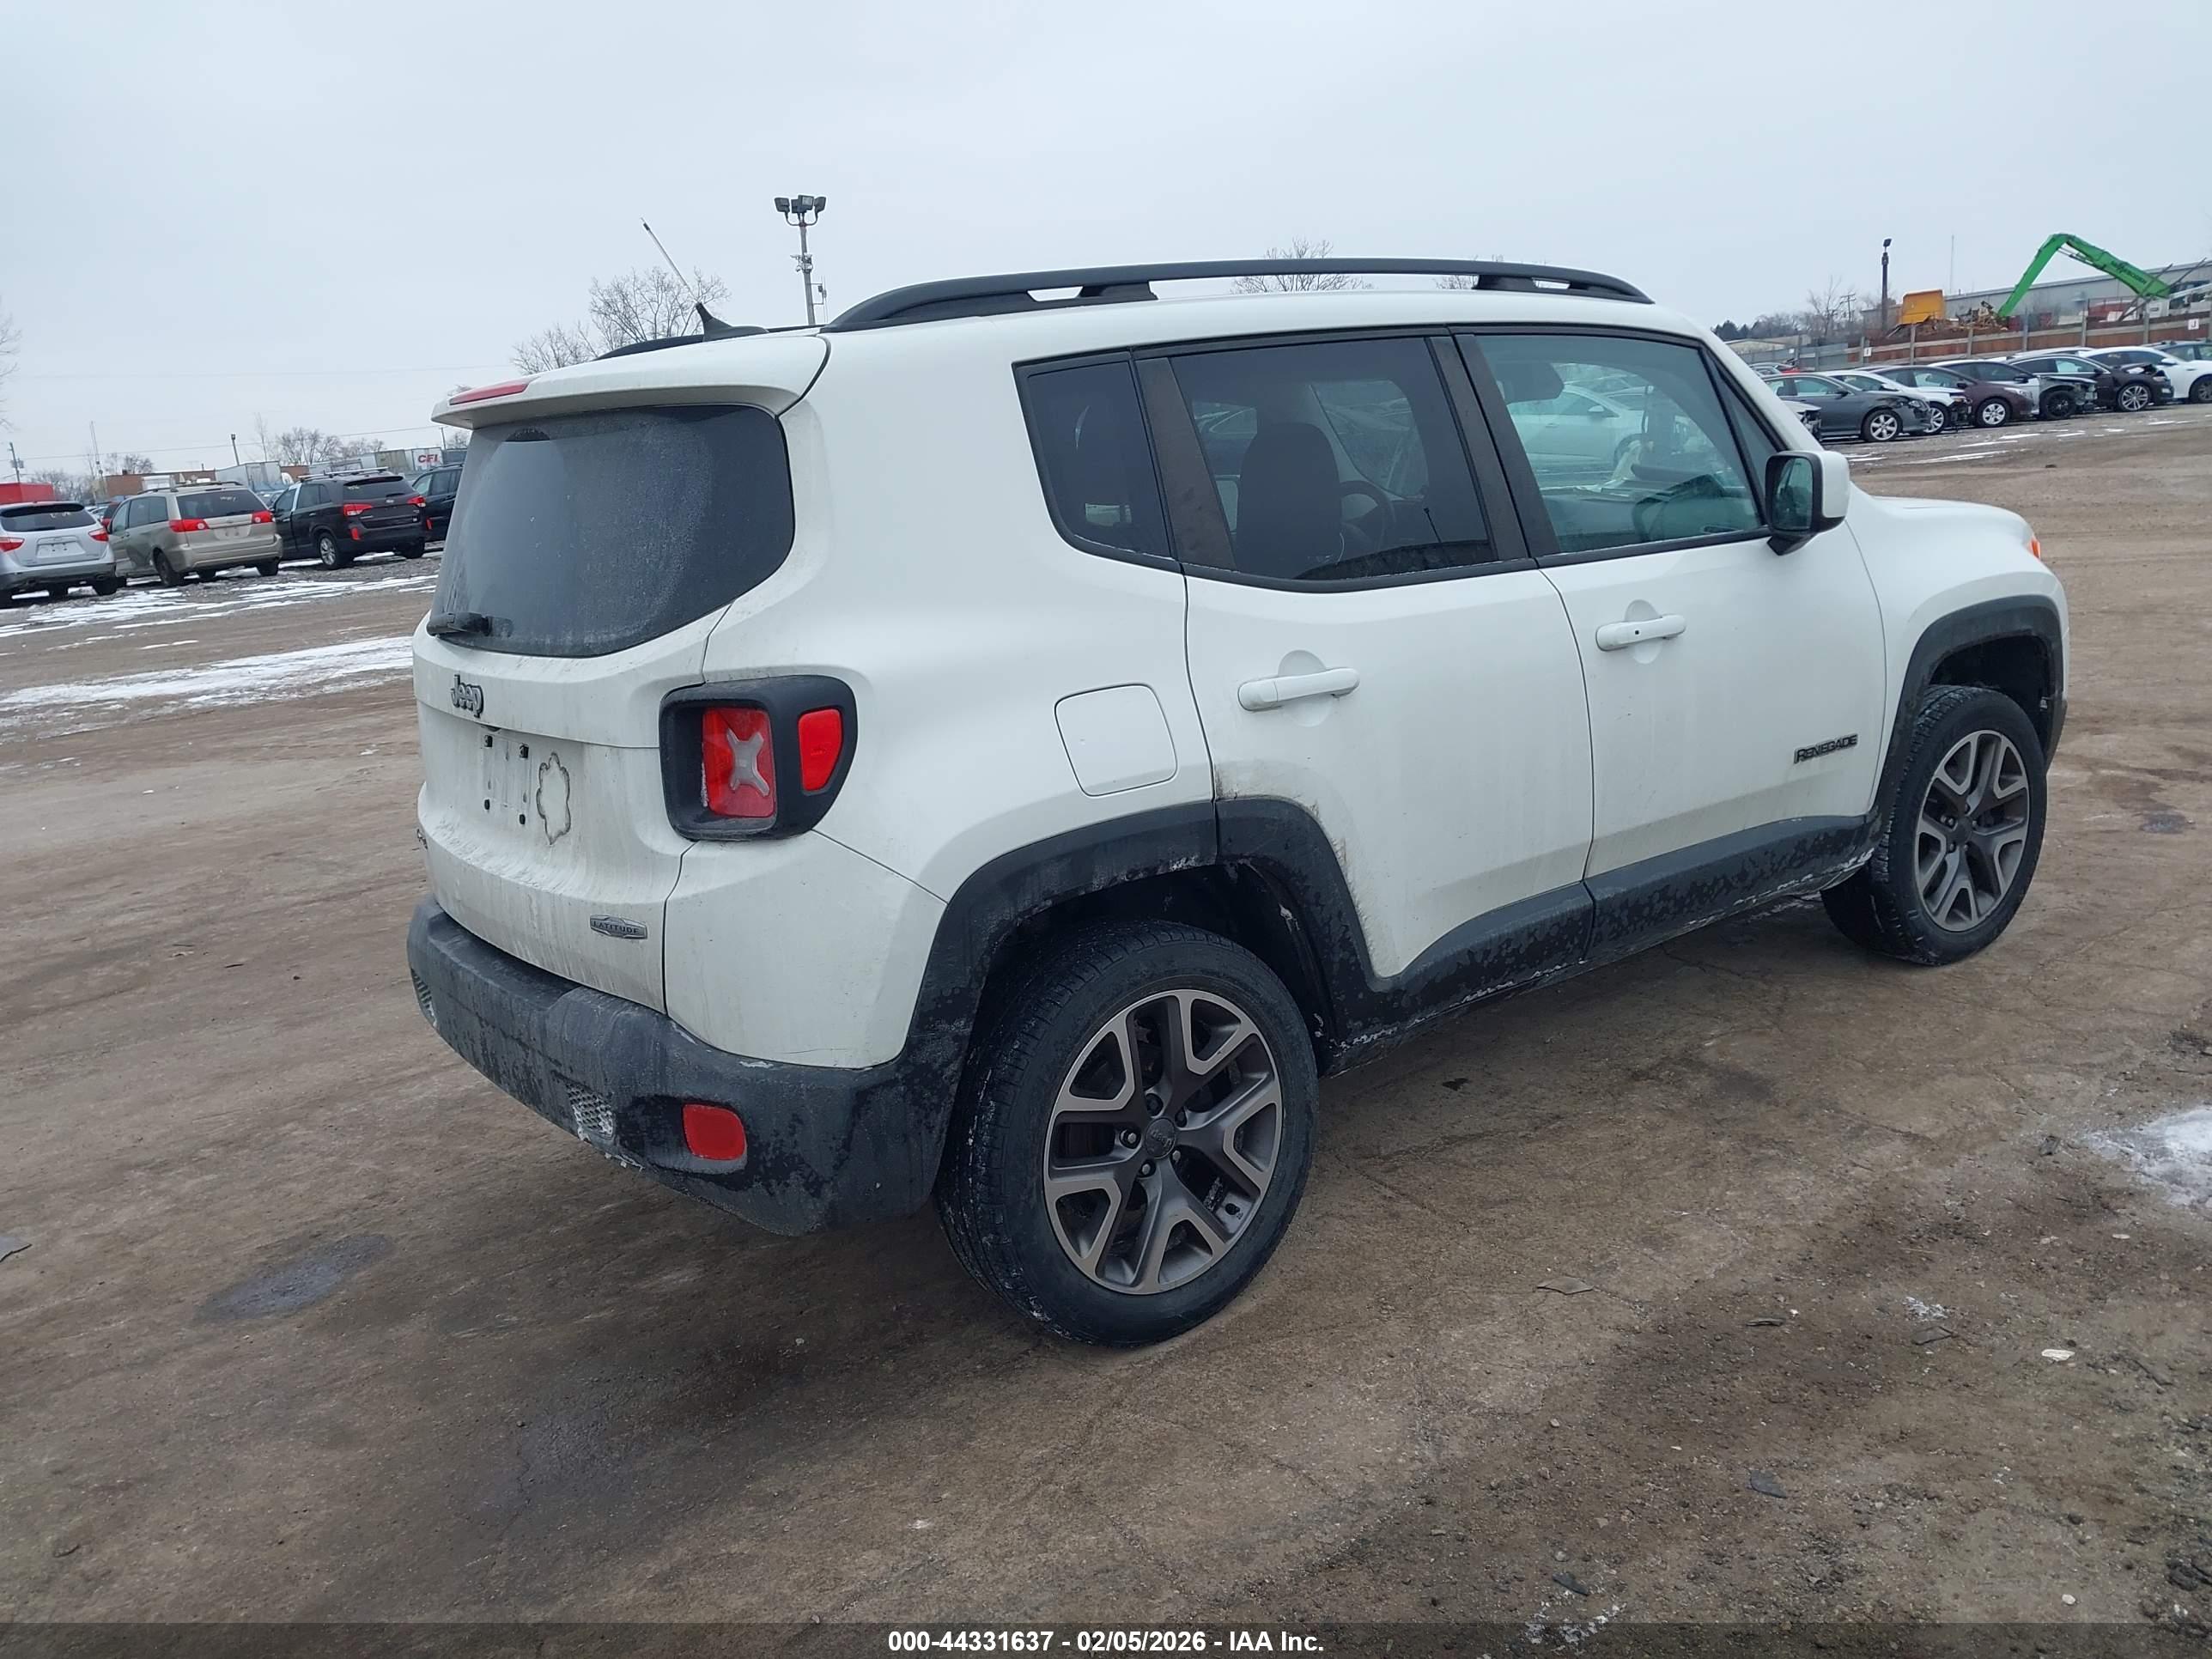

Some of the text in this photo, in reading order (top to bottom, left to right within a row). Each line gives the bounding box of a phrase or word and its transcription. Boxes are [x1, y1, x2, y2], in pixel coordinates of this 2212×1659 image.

[418, 454, 438, 463] CFI
[450, 674, 483, 719] Jeep
[1794, 734, 1858, 764] RENEGADE
[593, 921, 640, 933] LATITUDE
